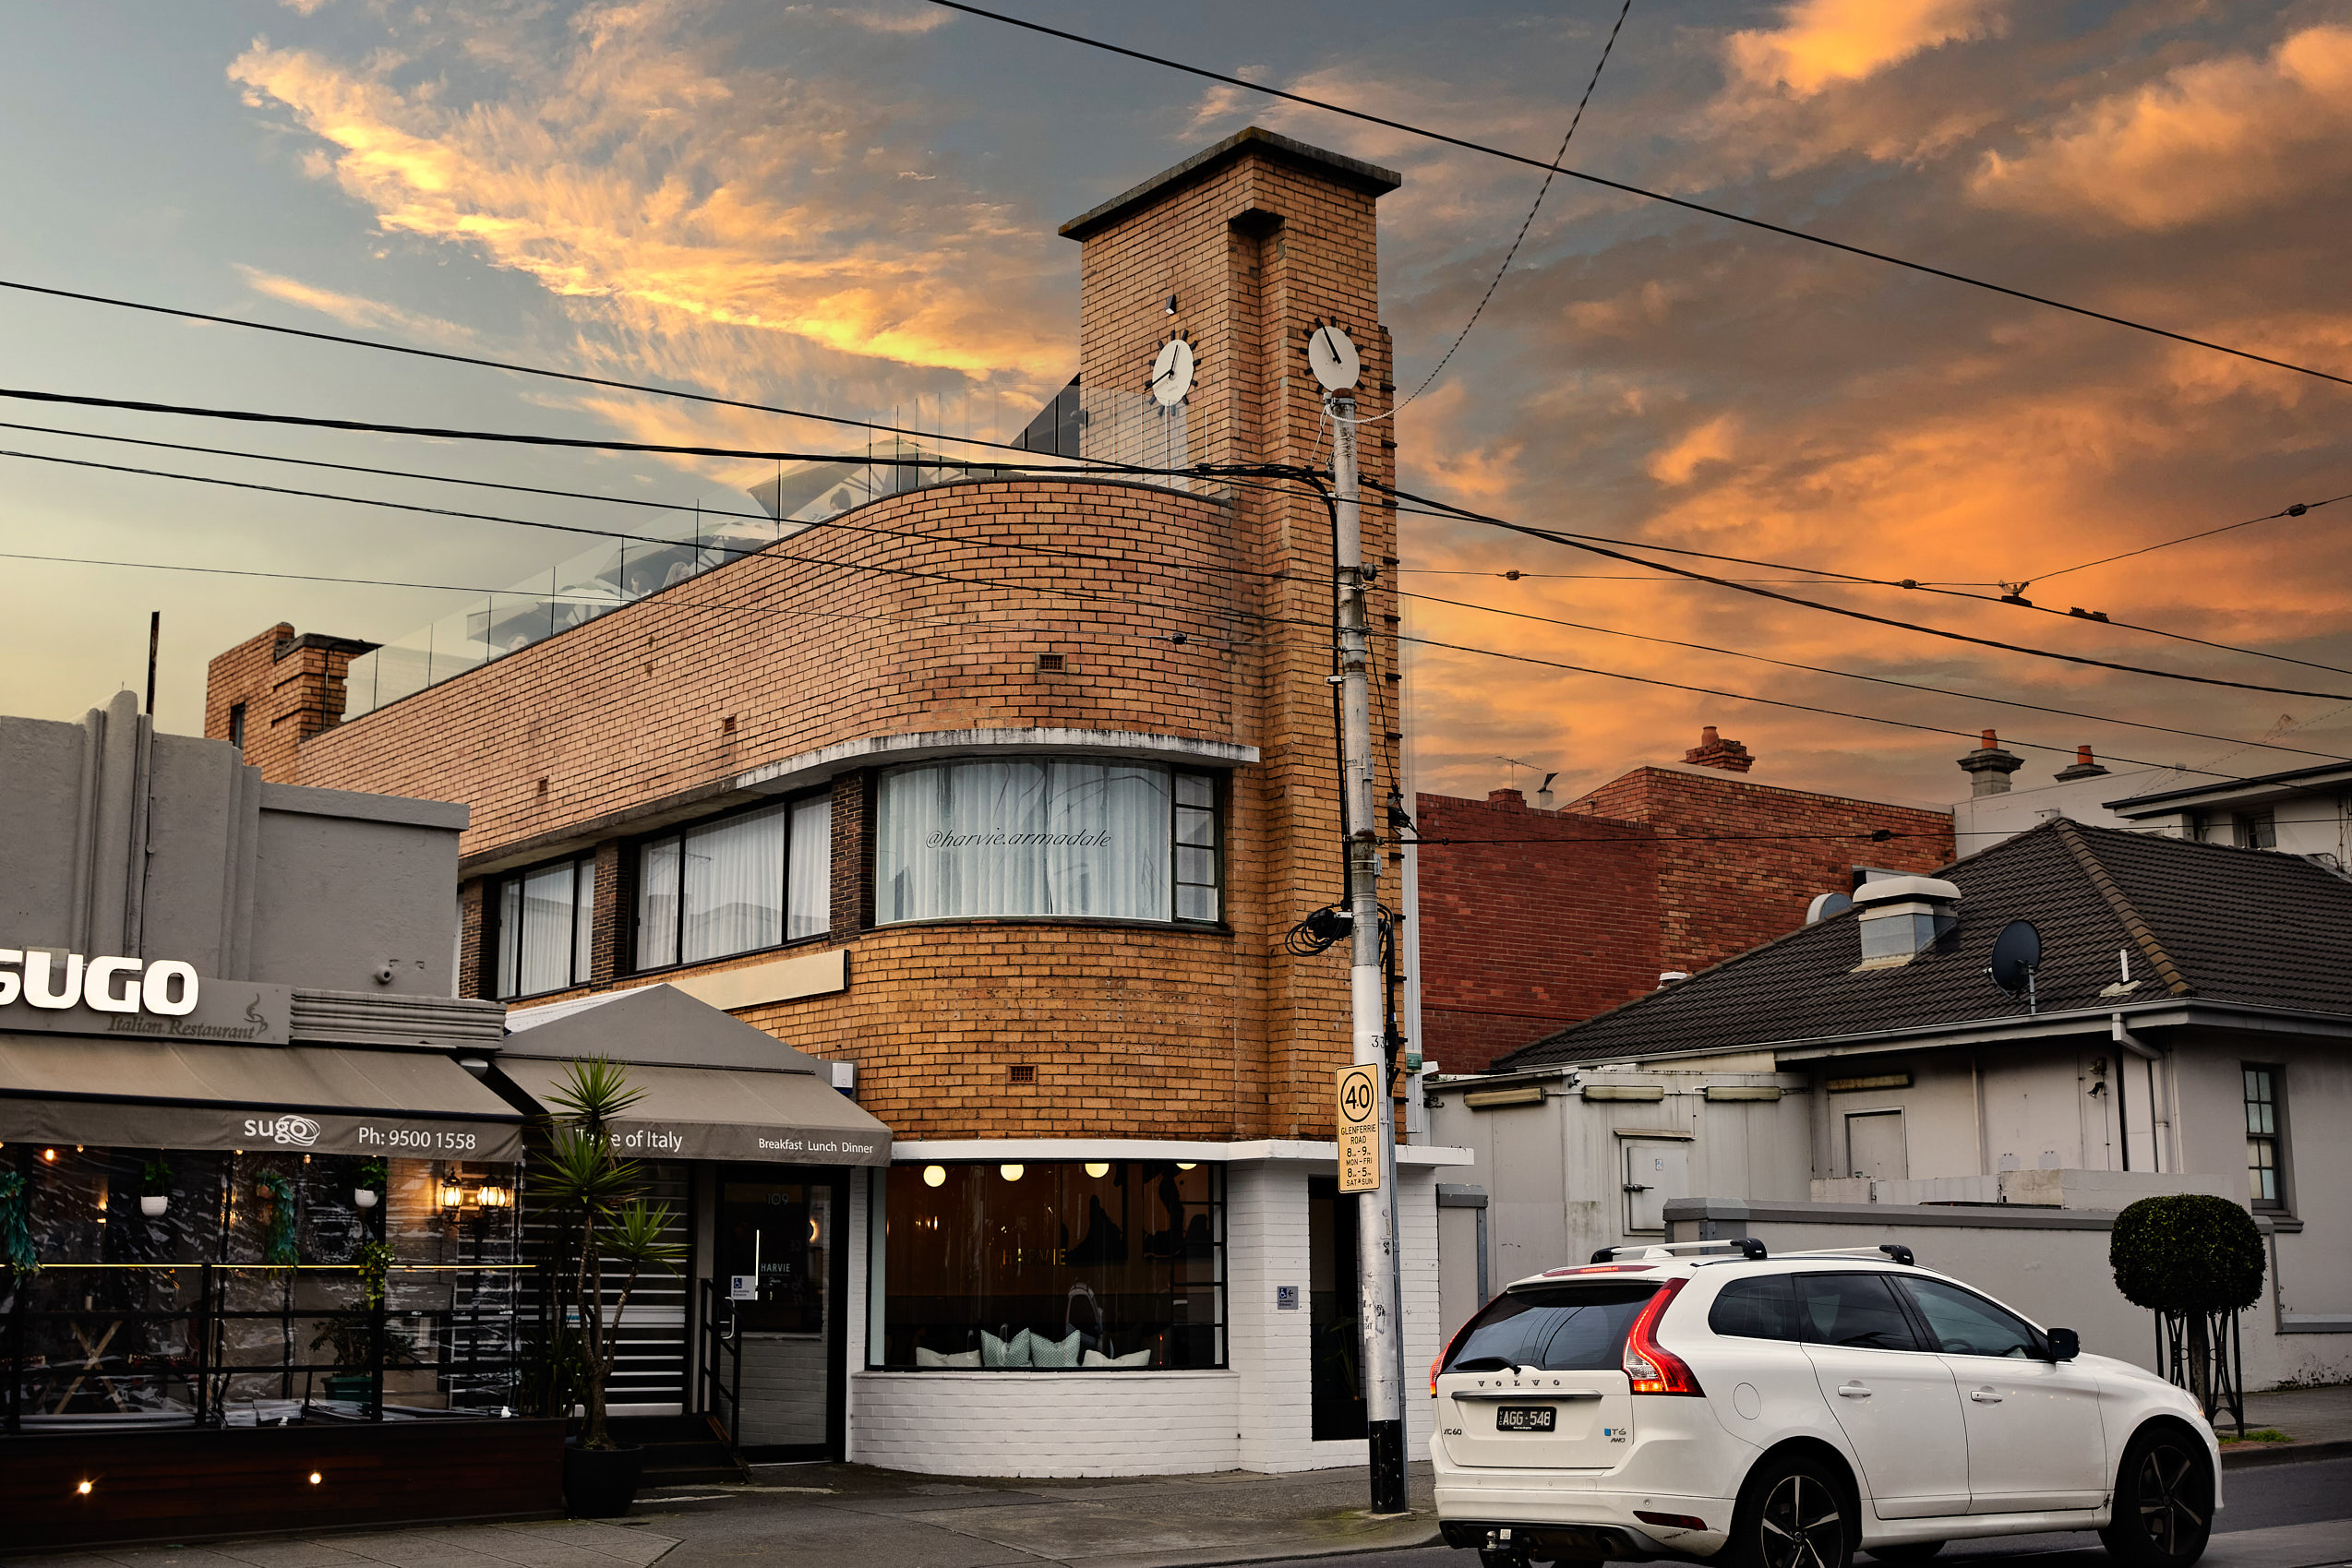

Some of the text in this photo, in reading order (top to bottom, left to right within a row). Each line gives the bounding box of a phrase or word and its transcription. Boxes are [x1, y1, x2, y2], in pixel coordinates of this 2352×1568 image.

[926, 827, 1112, 849] @harvie.armadale
[107, 1014, 255, 1039] Italian Restaurant
[1345, 1083, 1370, 1109] 40
[244, 1115, 314, 1145] sugo
[1340, 1123, 1376, 1136] GLENFERRIE
[358, 1127, 476, 1150] Ph: 9500 1558
[625, 1130, 644, 1147] of
[647, 1131, 683, 1153] Italy
[758, 1137, 873, 1154] Breakfast Lunch Dinner
[1350, 1135, 1367, 1144] ROAD
[767, 1192, 789, 1205] 109
[761, 1263, 791, 1273] HARVIE
[1478, 1379, 1560, 1387] VOLVO
[1611, 1428, 1626, 1436] T6
